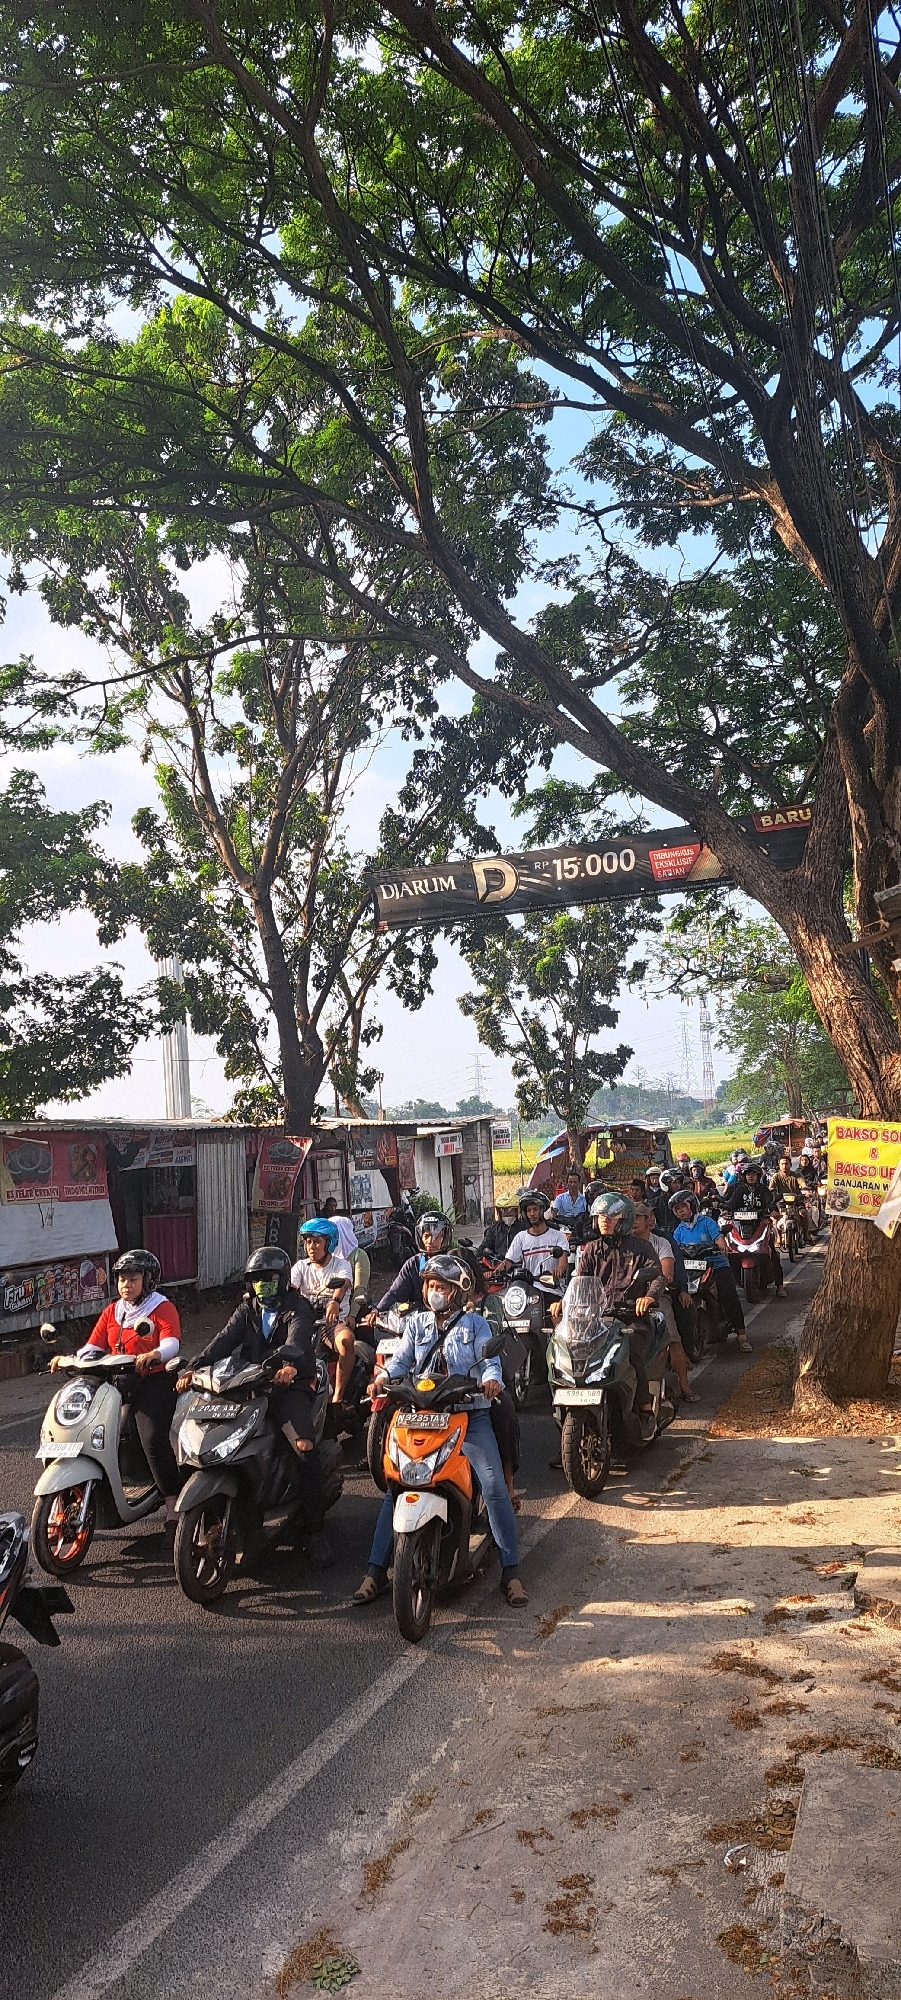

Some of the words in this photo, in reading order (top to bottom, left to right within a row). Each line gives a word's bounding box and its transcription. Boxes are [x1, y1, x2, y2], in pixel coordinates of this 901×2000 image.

[761, 808, 811, 827] BARU
[552, 848, 635, 881] 15.000
[380, 875, 457, 900] DJARUM
[835, 1126, 878, 1142] BAKSO
[869, 1147, 880, 1160] &
[834, 1161, 877, 1177] BAKSO
[833, 1178, 880, 1190] GANJARAN
[858, 1192, 870, 1206] 10
